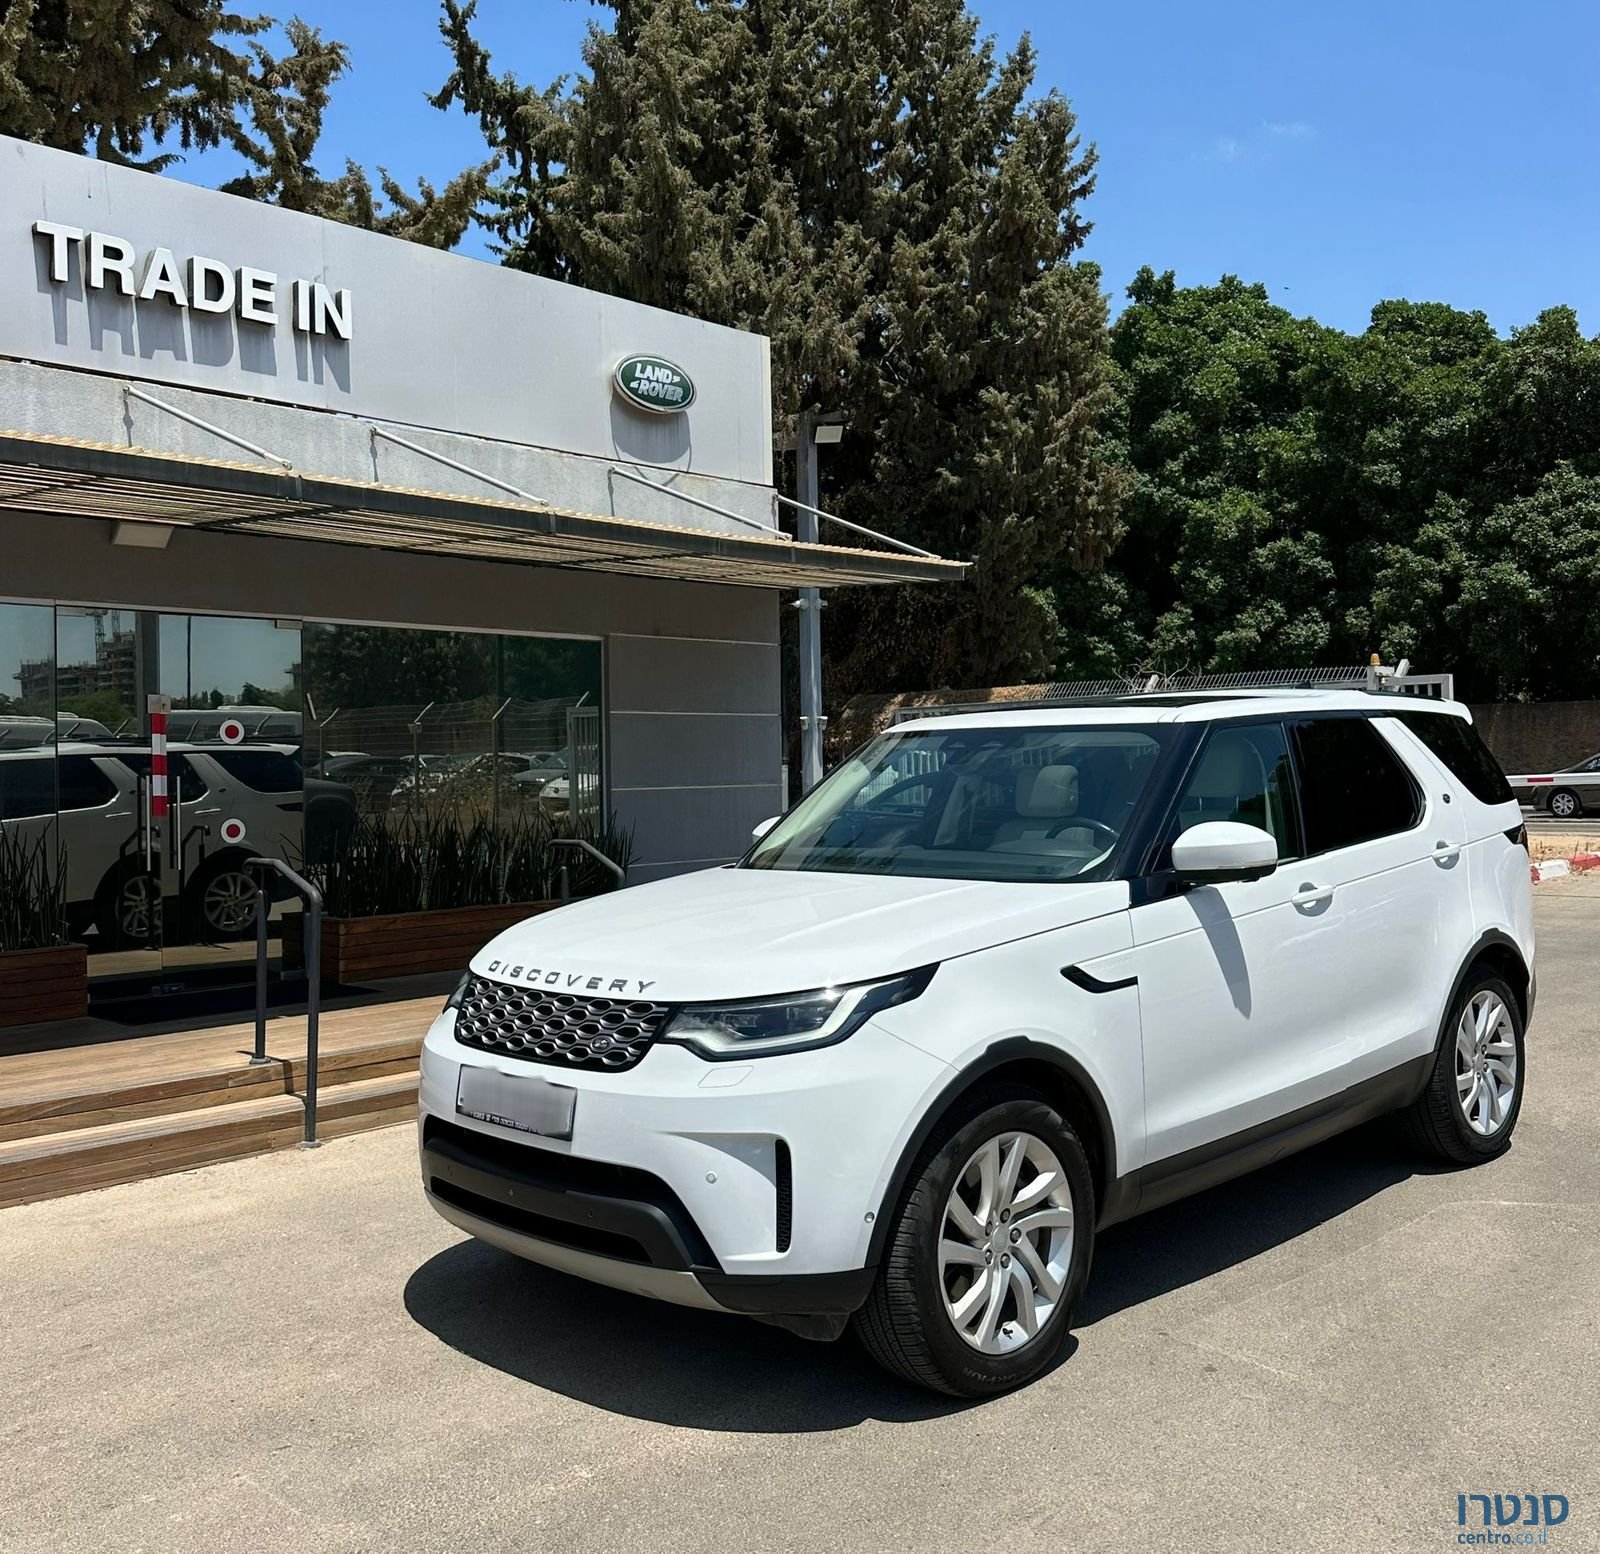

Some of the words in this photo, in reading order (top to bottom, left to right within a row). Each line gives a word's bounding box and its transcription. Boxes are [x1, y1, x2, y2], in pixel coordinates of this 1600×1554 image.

[33, 220, 279, 325] TRADE
[293, 279, 352, 340] IN
[634, 362, 673, 384] LAND
[637, 379, 684, 402] ROVER
[488, 960, 656, 994] DISCOVERY
